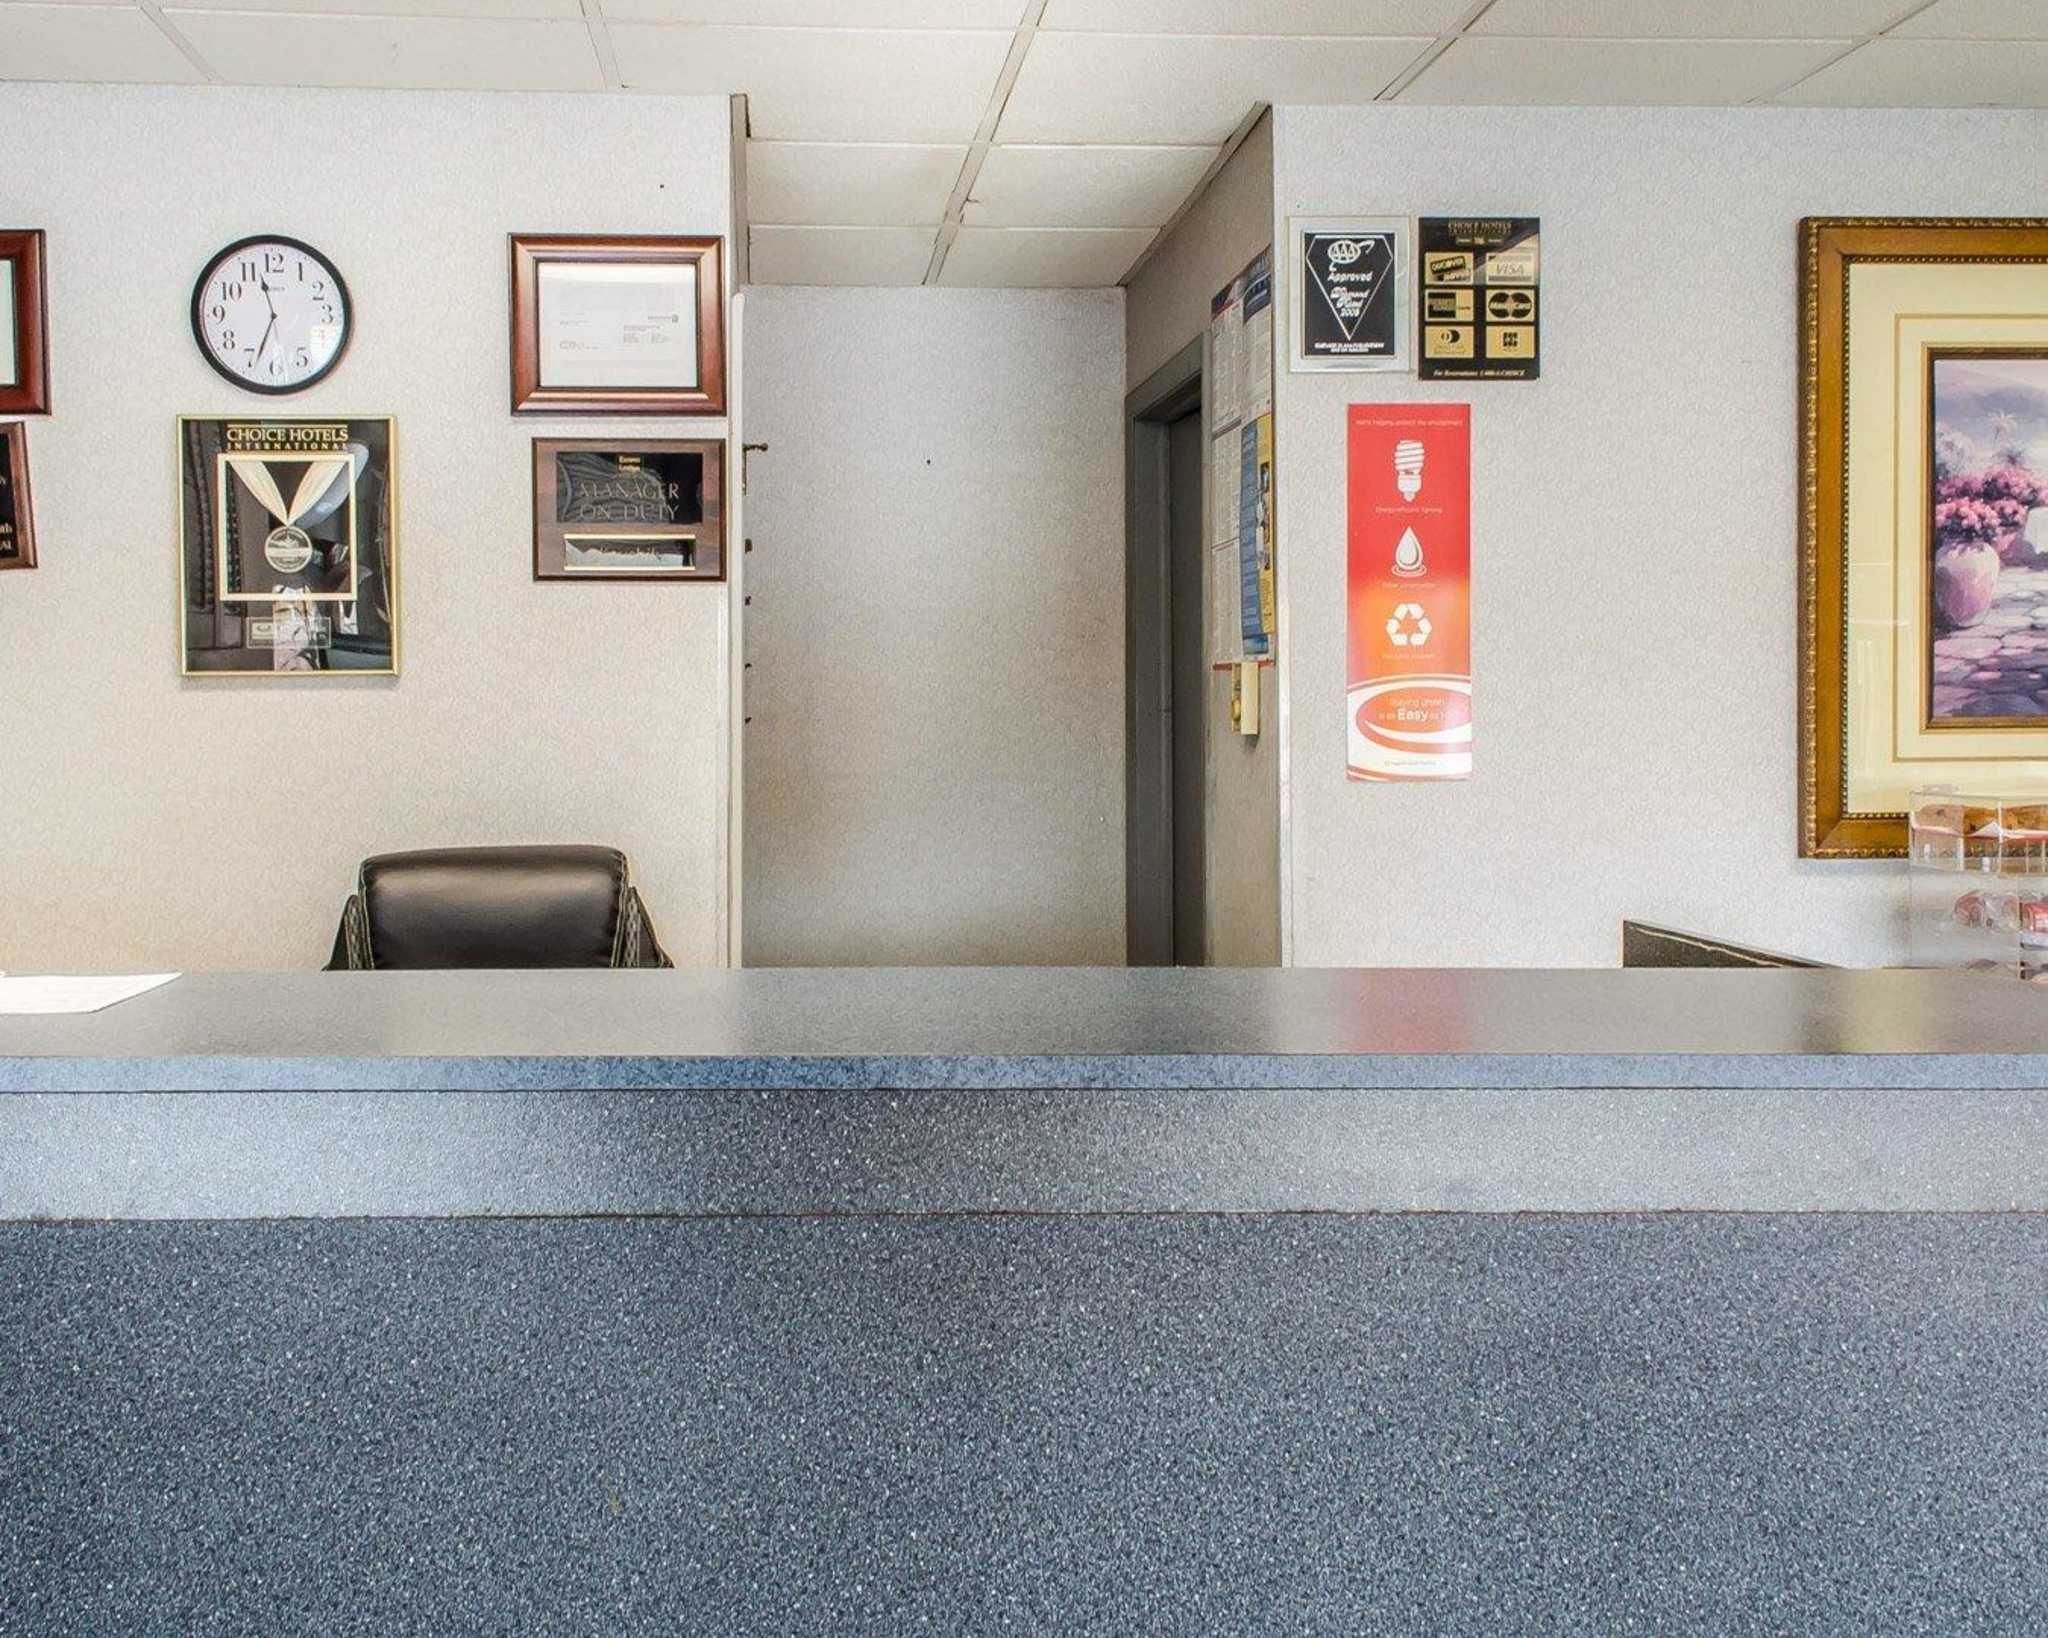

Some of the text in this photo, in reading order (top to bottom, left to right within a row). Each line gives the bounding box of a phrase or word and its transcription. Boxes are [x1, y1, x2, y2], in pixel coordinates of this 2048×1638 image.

[241, 262, 256, 282] 11
[265, 253, 284, 273] 12
[298, 262, 303, 282] 1
[1497, 263, 1524, 274] VISA
[1328, 272, 1373, 282] Approved
[222, 281, 242, 301] 10
[312, 281, 325, 301] 2
[212, 305, 225, 324] 9
[321, 304, 334, 324] 3
[223, 329, 236, 350] 8
[244, 347, 256, 368] 7
[296, 347, 309, 367] 5
[226, 428, 349, 441] CHOICE HOTELS
[227, 442, 349, 450] INTERNATIONAL
[579, 482, 680, 499] MANAGER
[579, 504, 679, 520] ON DUTY
[1397, 708, 1429, 721] Easy
